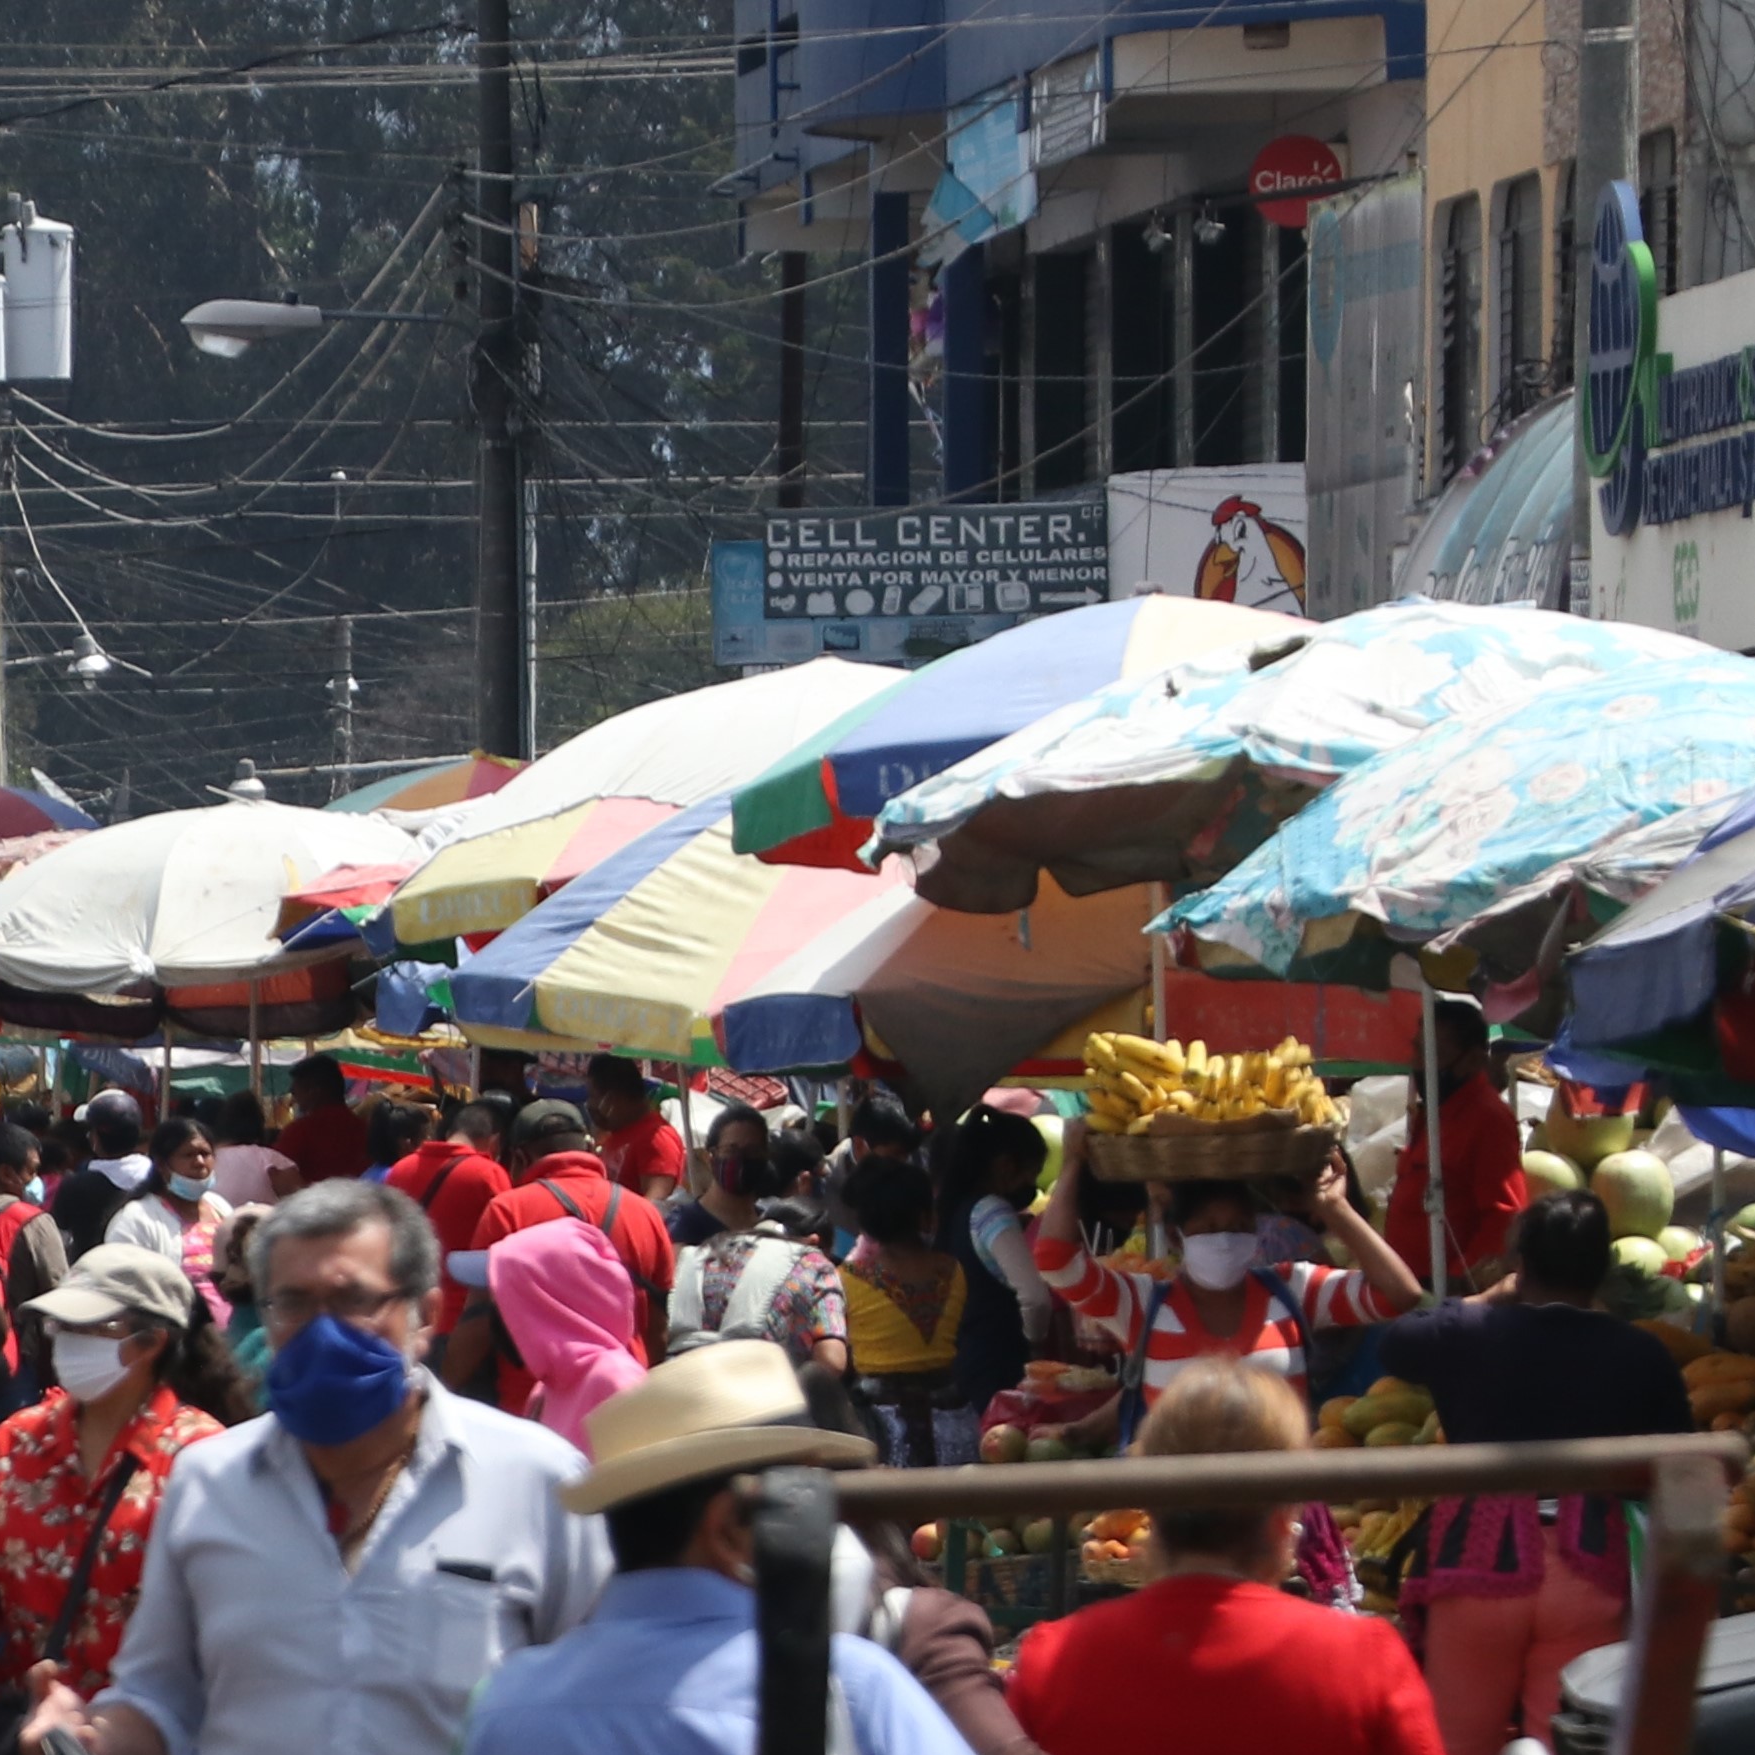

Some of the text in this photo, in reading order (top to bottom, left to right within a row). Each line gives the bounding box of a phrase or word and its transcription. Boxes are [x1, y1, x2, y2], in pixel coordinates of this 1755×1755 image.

[1255, 169, 1324, 193] Claro
[767, 518, 878, 549] CELL
[786, 546, 1108, 569] REPARACION DE CELULARES
[789, 565, 1108, 588] VENTA POR MAYOR Y MENOR
